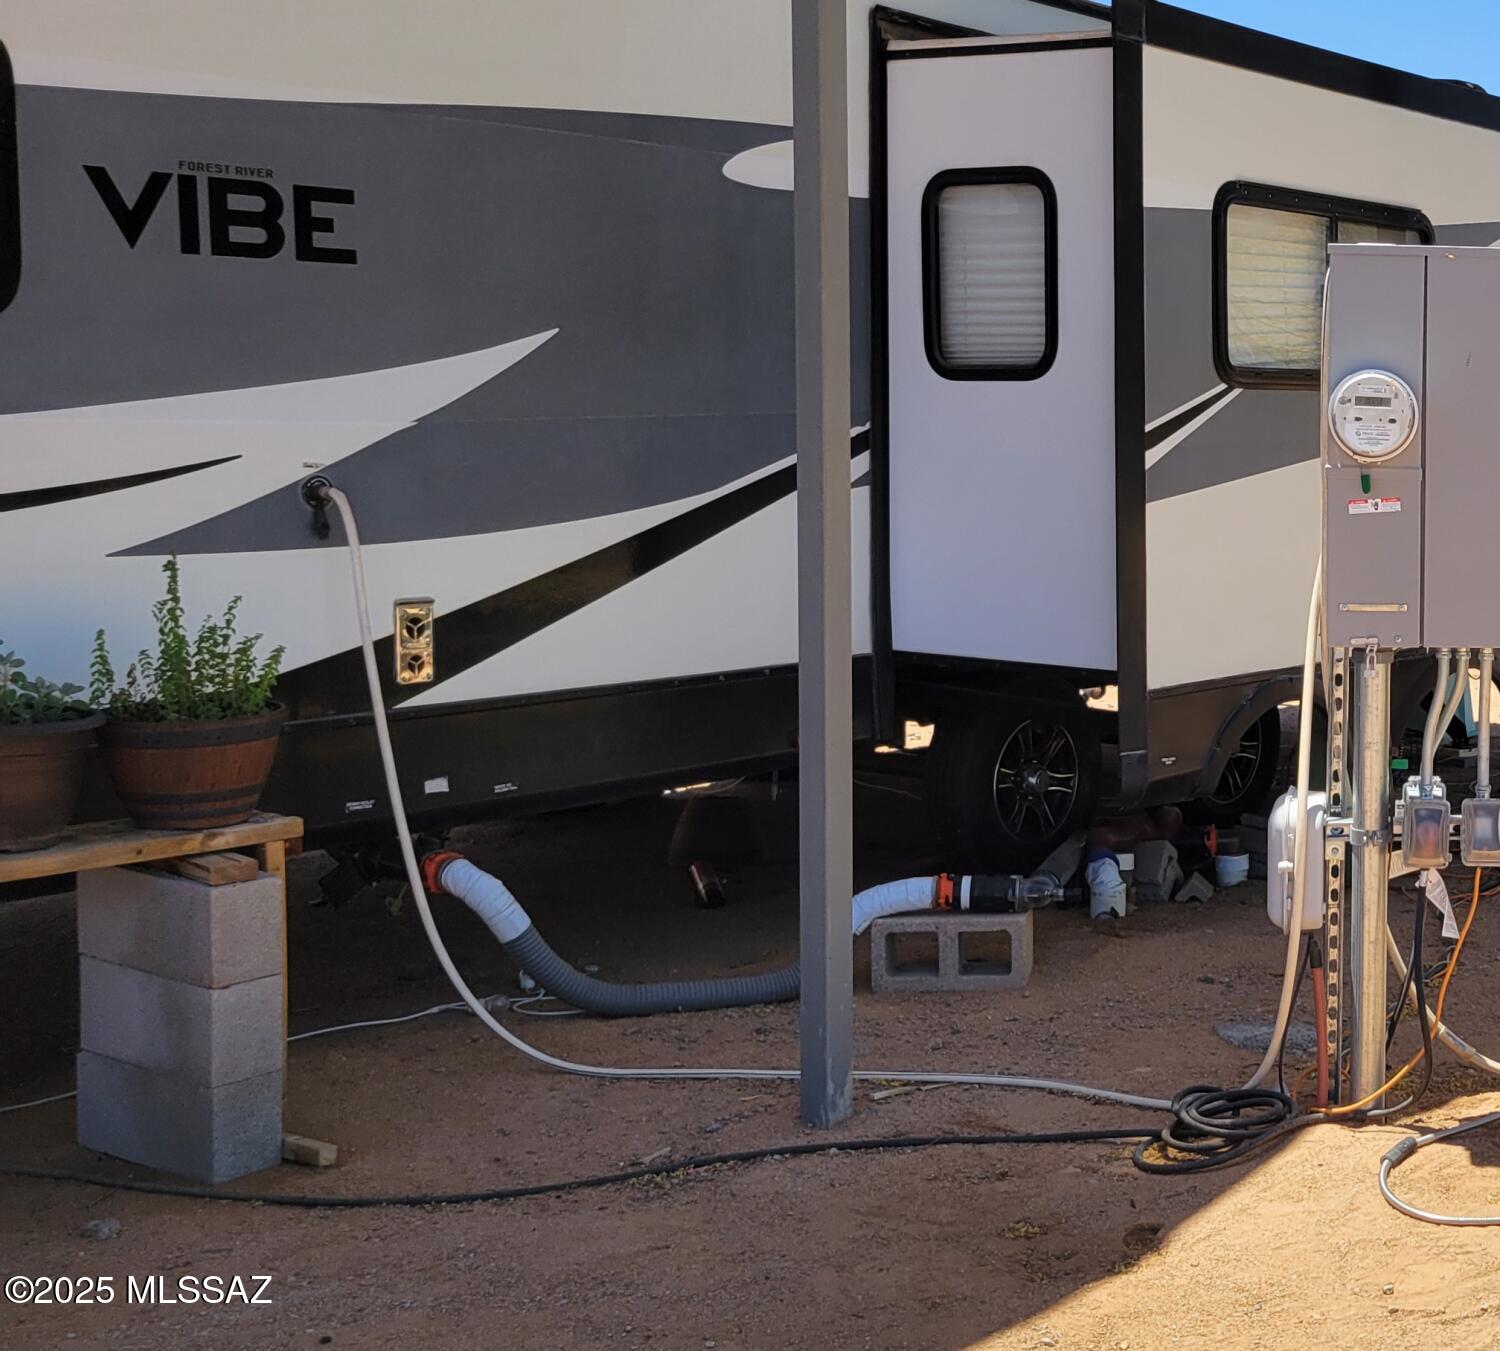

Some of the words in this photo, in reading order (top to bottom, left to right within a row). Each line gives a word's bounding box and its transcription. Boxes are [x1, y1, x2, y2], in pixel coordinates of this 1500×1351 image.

[178, 160, 231, 175] FOREST
[235, 165, 274, 179] RIVER
[82, 164, 357, 265] VIBE
